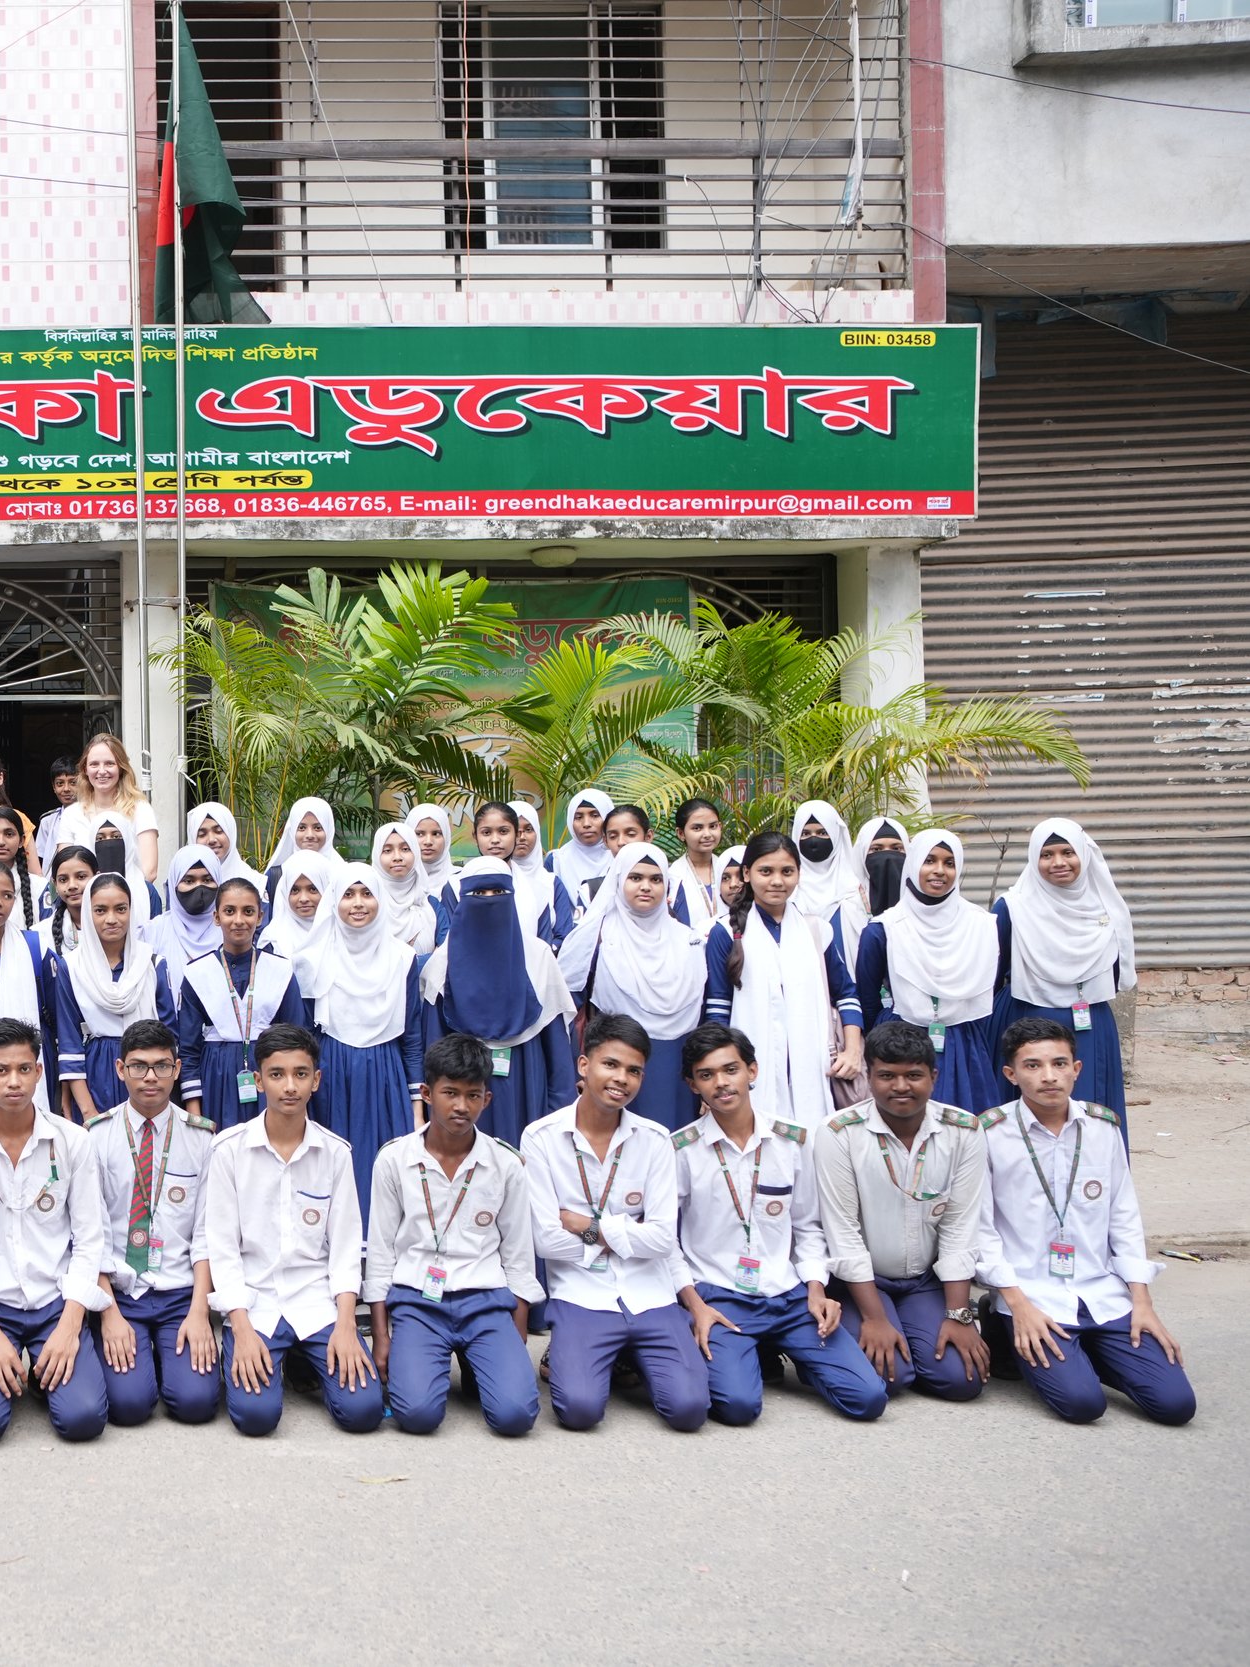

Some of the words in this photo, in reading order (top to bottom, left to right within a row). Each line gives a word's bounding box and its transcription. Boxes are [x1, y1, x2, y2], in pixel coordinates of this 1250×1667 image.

[121, 328, 177, 342] রামানির
[184, 327, 217, 341] রাহিম
[844, 334, 880, 345] BIIN:
[886, 334, 931, 345] 03458
[20, 346, 73, 370] কর্তৃক
[184, 343, 236, 361] শিক্ষা
[242, 342, 318, 361] প্রতিষ্ঠান
[196, 366, 915, 457] এডুকেয়ার
[18, 452, 80, 471] গড়বে
[247, 448, 352, 467] বাংলাদেশ
[76, 477, 137, 489] ১০ম
[234, 471, 307, 487] পর্যন্ত
[234, 496, 392, 513] 01836-446765,
[400, 495, 477, 512] E-mail:
[485, 495, 912, 515] greendhakaeducaremirpur@gmail.com
